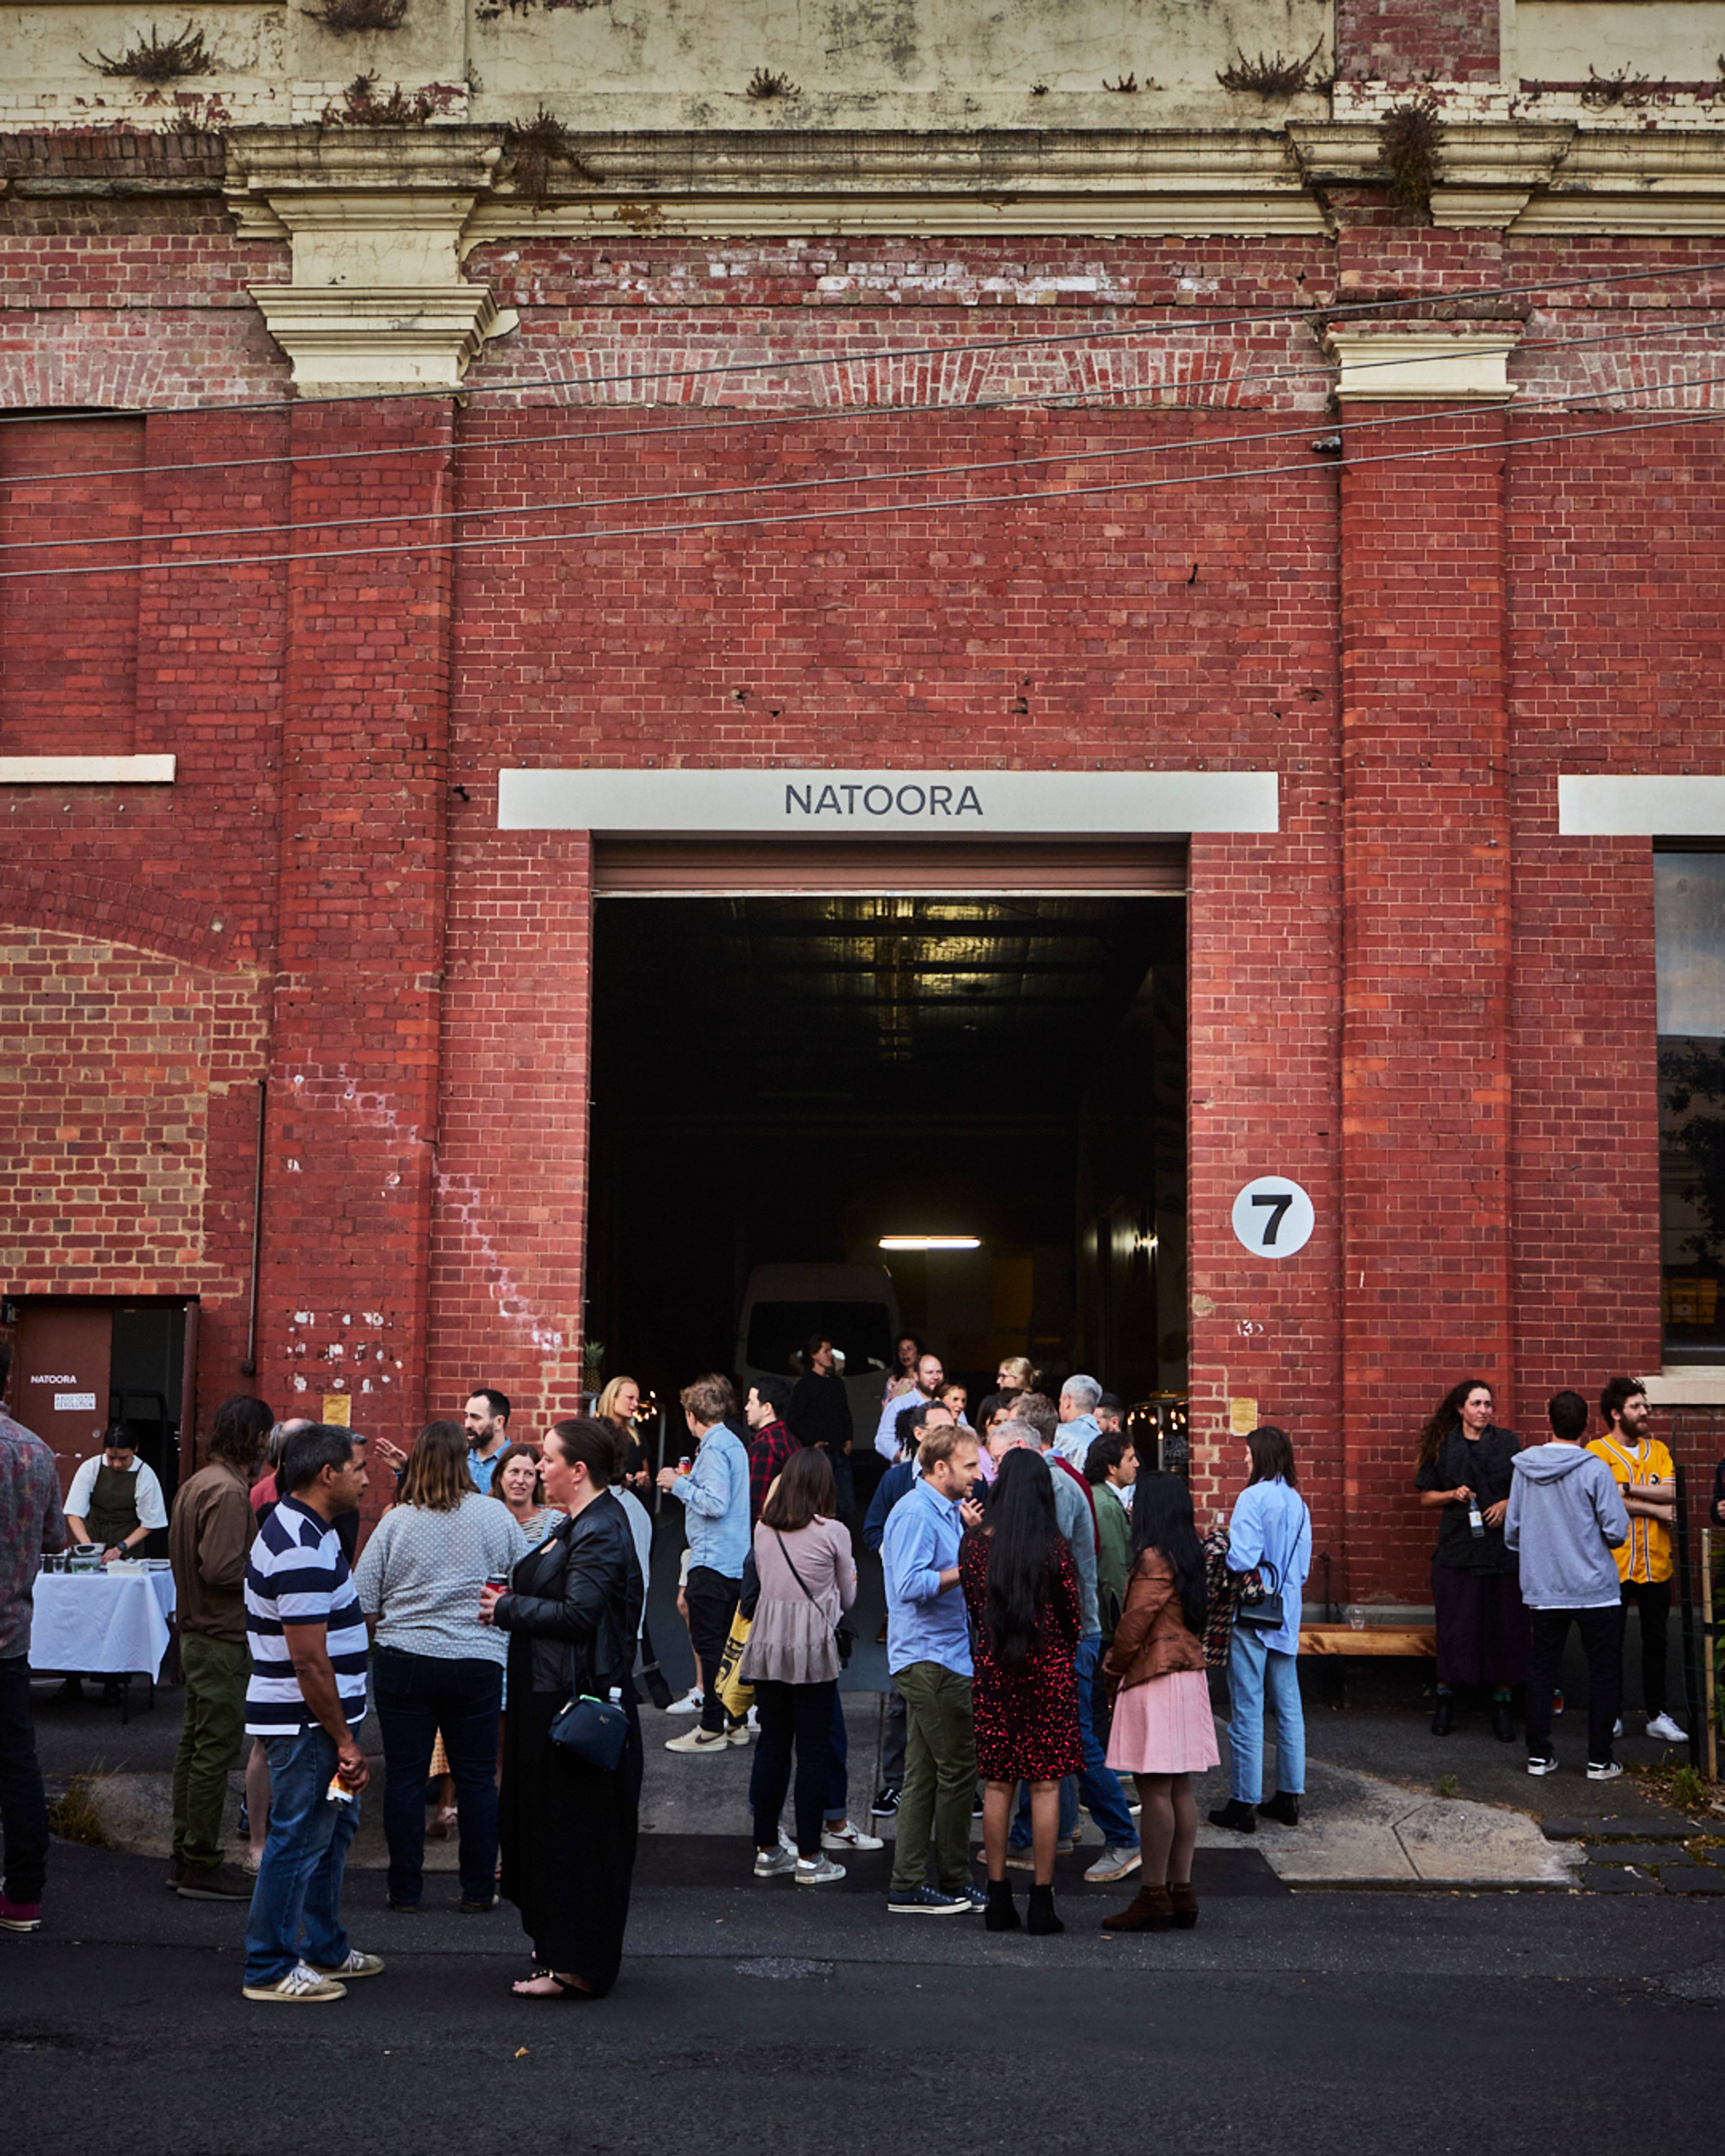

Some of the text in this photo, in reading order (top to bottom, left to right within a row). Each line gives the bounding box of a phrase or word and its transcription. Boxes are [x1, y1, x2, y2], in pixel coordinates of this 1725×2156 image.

[785, 784, 984, 815] NATOORA
[1252, 1194, 1293, 1246] 7
[31, 1375, 77, 1384] NATOORA
